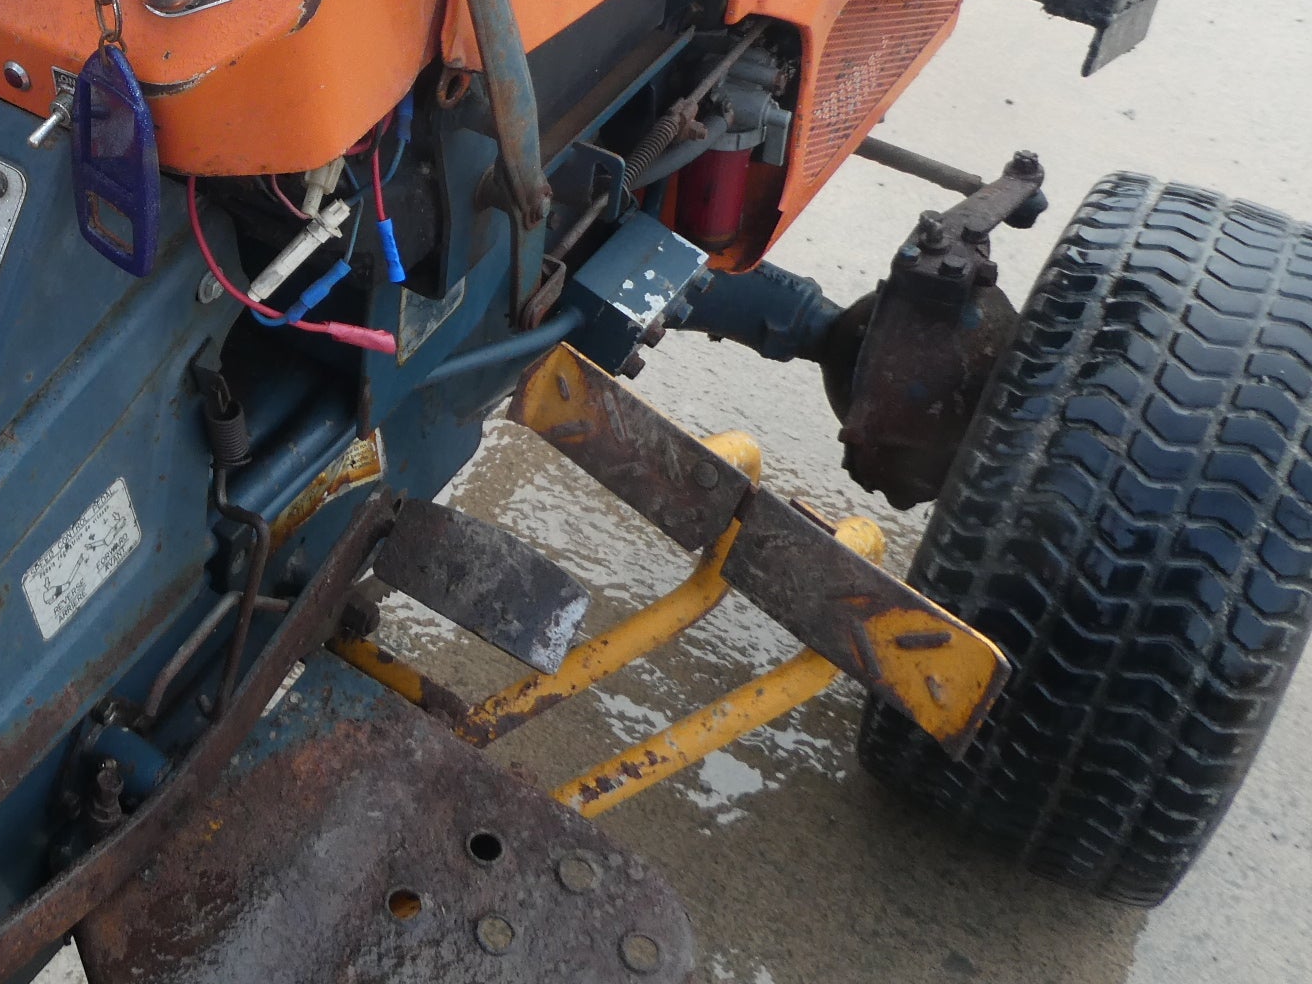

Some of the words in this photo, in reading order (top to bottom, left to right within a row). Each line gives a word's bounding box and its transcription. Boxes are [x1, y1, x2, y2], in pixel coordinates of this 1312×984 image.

[95, 532, 129, 571] FORWARD
[104, 547, 127, 572] AVANT
[53, 578, 86, 616] REVERSE
